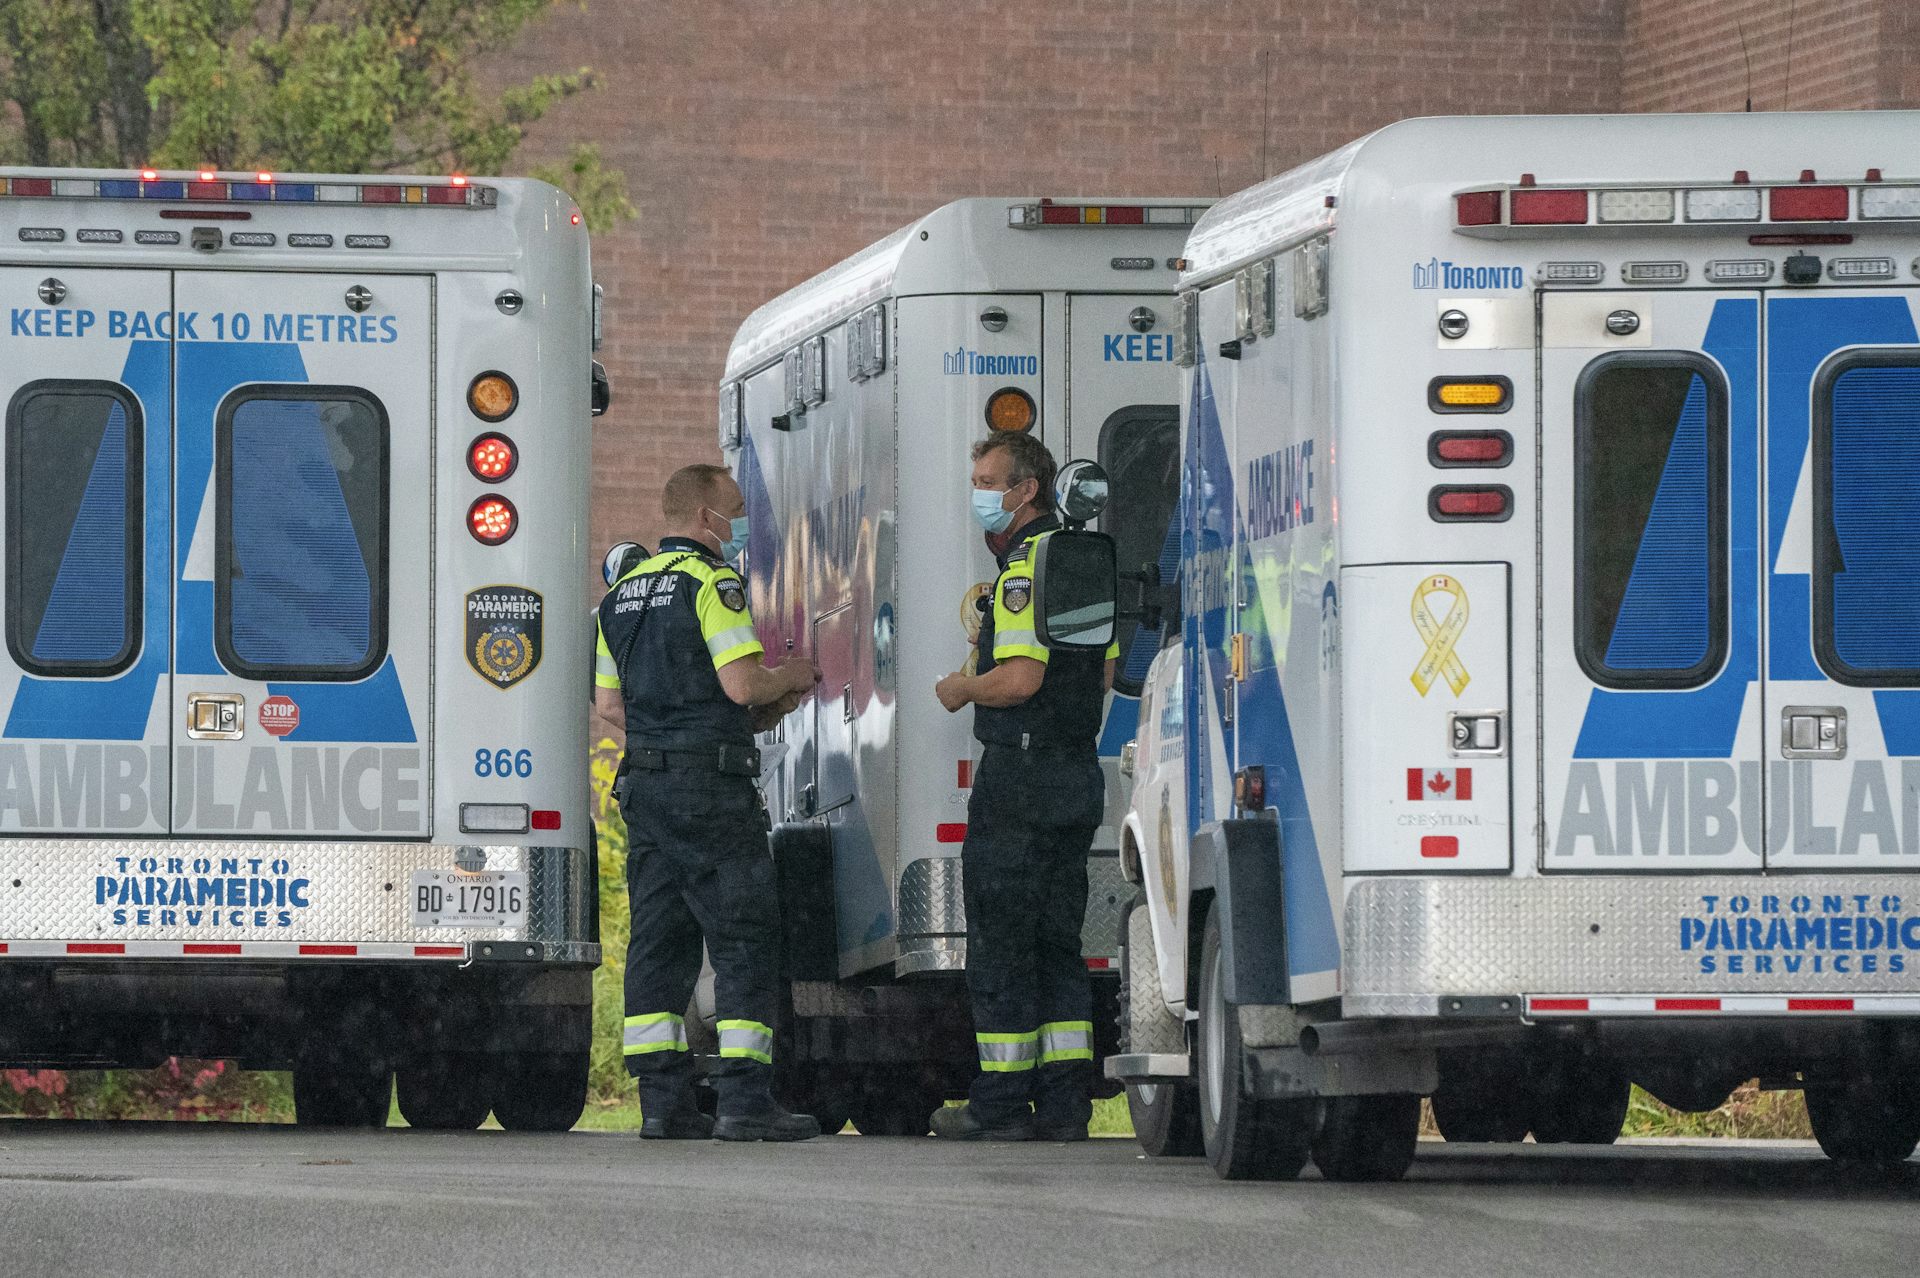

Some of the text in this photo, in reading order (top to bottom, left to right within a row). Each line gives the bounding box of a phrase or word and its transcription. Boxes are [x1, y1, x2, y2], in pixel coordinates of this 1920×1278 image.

[1440, 261, 1523, 289] TORONTO
[11, 308, 398, 343] KEEP BACK 10 METRES
[966, 351, 1037, 375] TORONTO
[468, 600, 541, 613] PARAMEDIC
[475, 594, 535, 602] TORONTO
[474, 612, 535, 620] SERVICES
[263, 703, 295, 717] STOP
[475, 748, 533, 778] 866
[0, 743, 420, 832] AMBULANCE
[115, 857, 290, 875] TORONTO
[446, 873, 493, 884] ONTARIO
[96, 876, 309, 908] PARAMEDIC
[417, 885, 521, 914] BD 17916
[1702, 895, 1902, 914] TORONTO
[113, 909, 292, 927] SERVICES
[1700, 954, 1906, 974] SERVICES
